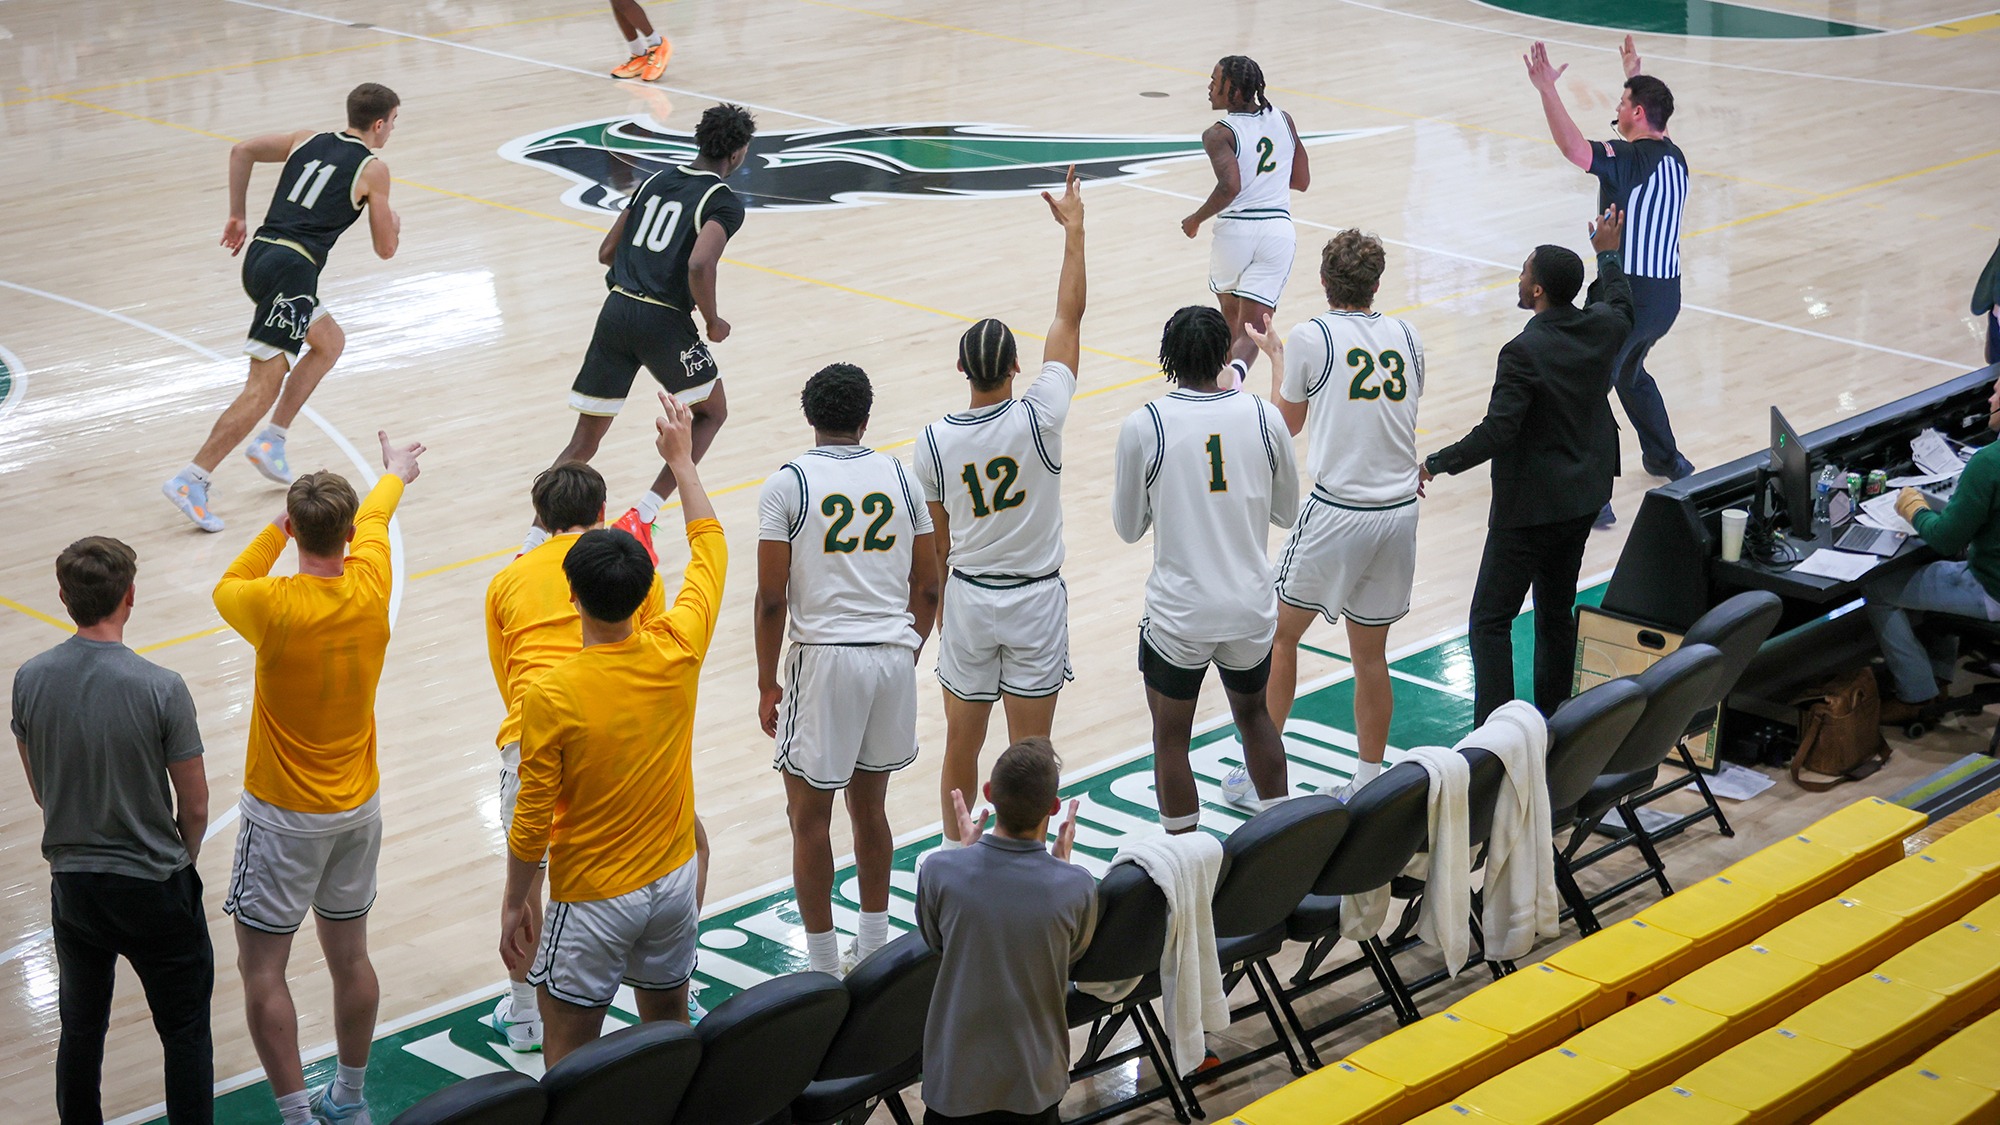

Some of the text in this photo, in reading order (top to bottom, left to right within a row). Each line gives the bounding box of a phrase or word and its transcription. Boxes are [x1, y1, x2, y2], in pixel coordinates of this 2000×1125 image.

[286, 158, 337, 210] 11
[1256, 136, 1277, 176] 2
[632, 194, 683, 252] 10
[1347, 347, 1408, 402] 23
[960, 456, 1026, 517] 12
[1204, 433, 1228, 493] 1
[821, 492, 896, 554] 22
